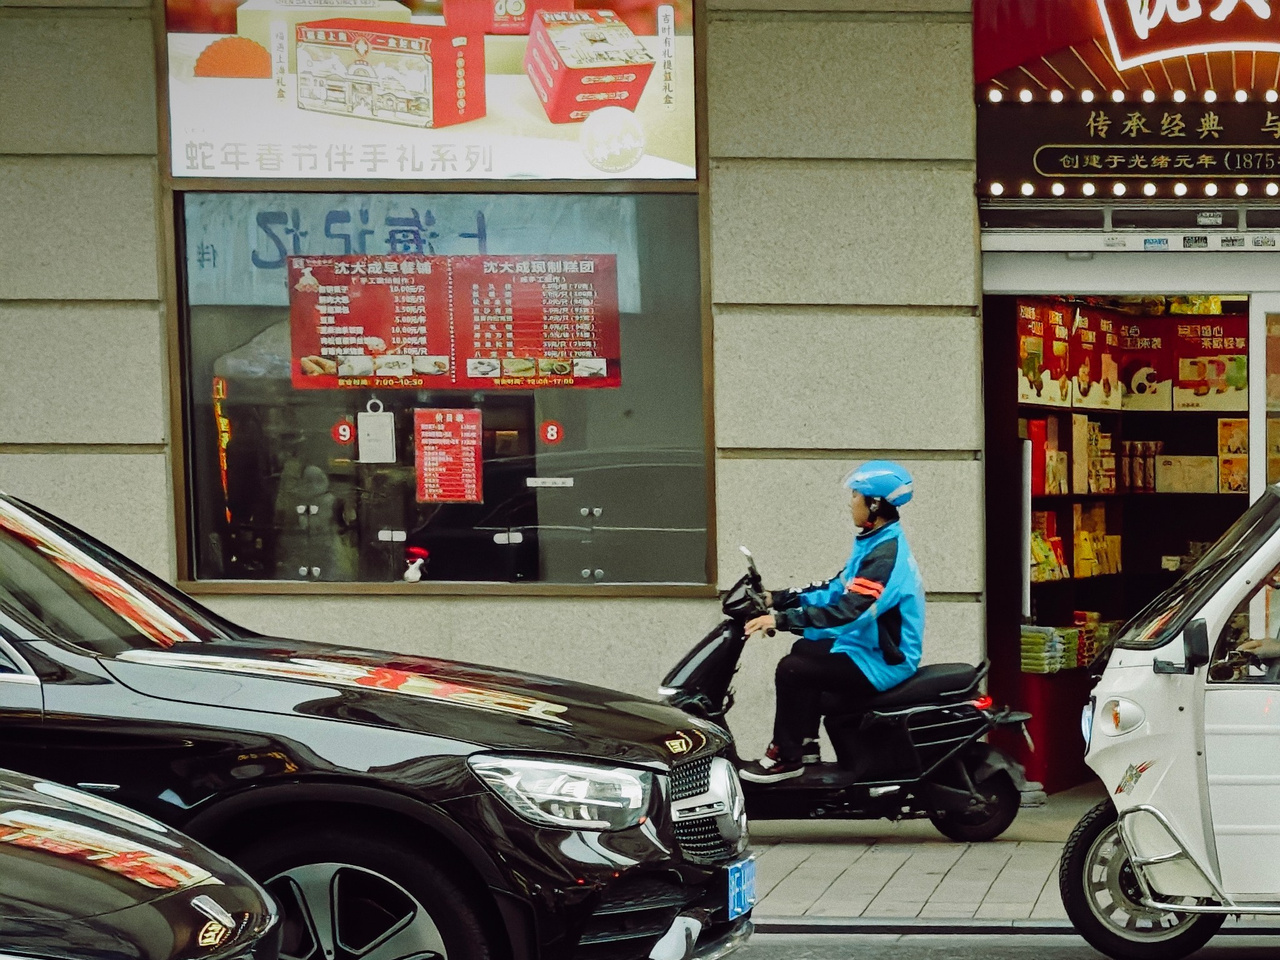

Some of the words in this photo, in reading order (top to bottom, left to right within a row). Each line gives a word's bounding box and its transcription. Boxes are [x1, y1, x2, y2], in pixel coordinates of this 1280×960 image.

[1086, 110, 1225, 140] 传承经典
[185, 140, 493, 172] 蛇年春节伴手礼系列
[483, 260, 595, 274] 沈大成现制糕团
[338, 424, 351, 441] 9
[545, 424, 558, 441] 8
